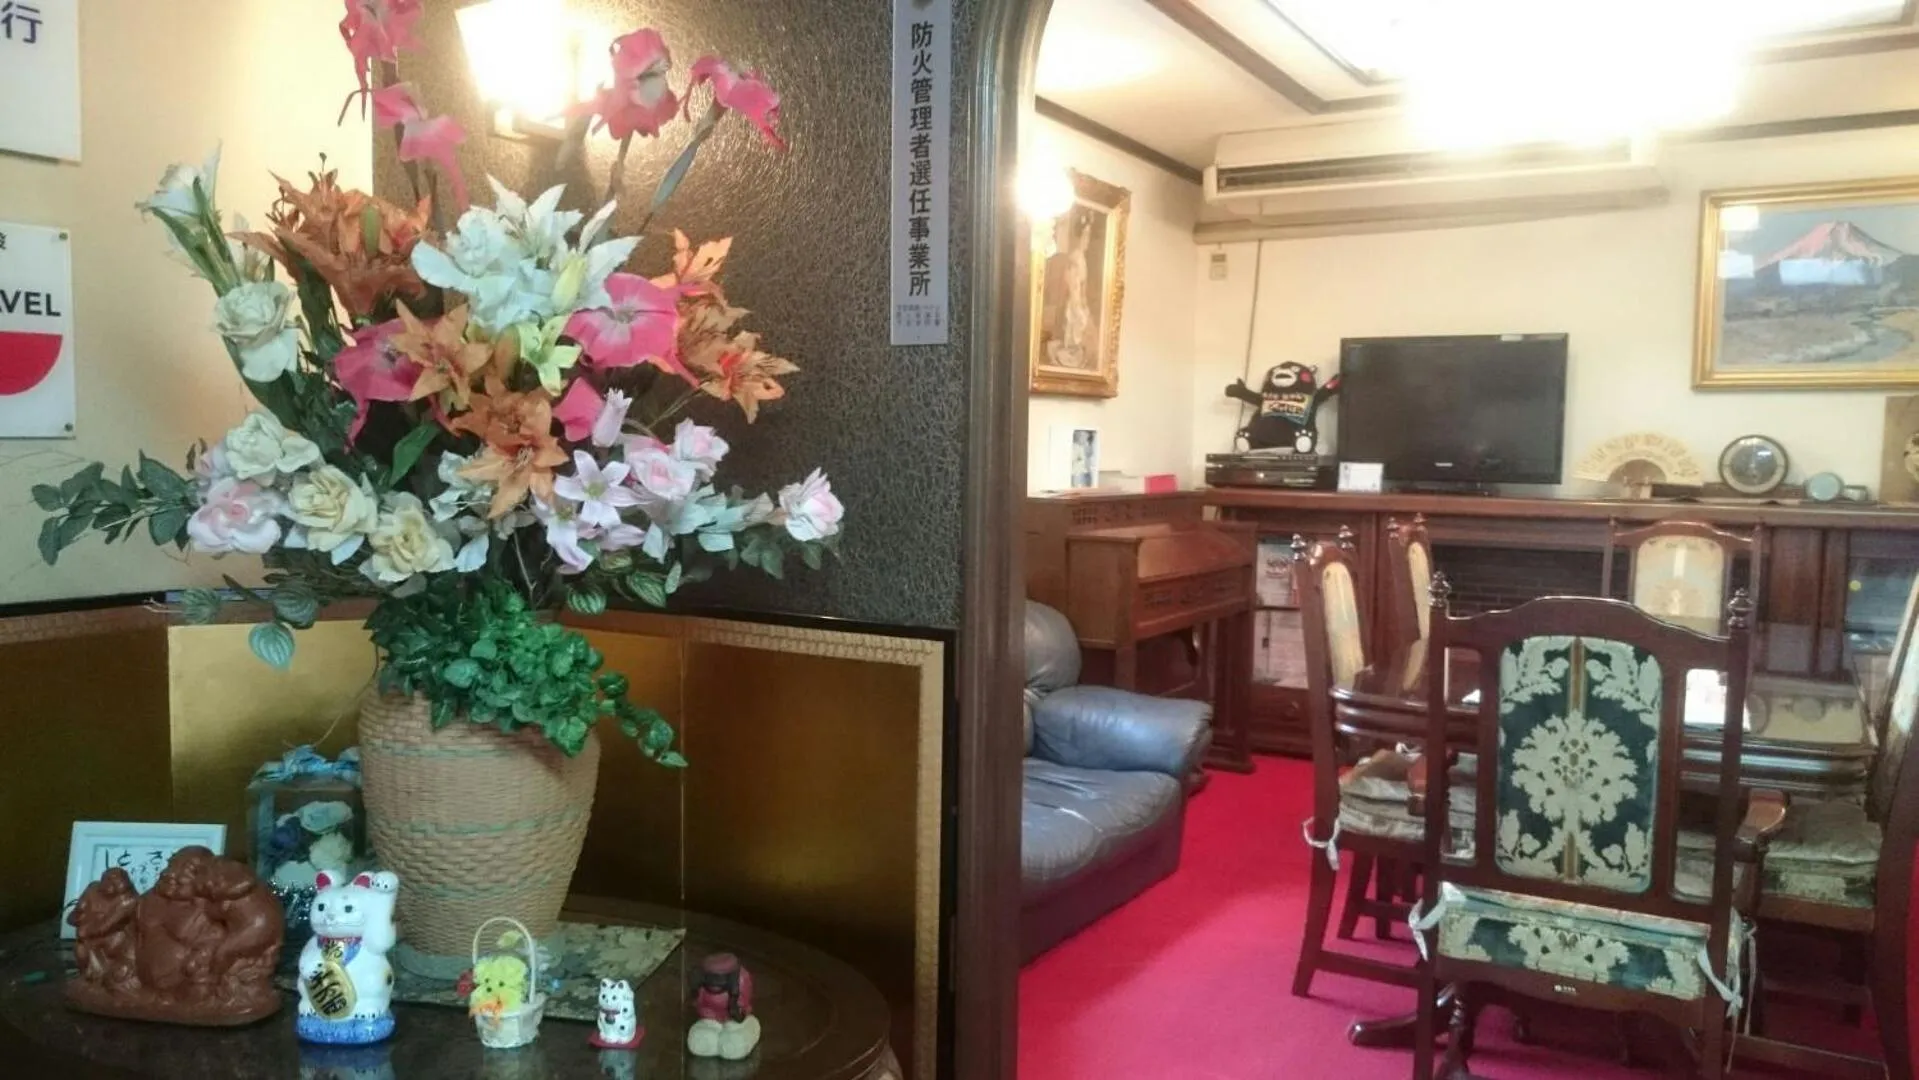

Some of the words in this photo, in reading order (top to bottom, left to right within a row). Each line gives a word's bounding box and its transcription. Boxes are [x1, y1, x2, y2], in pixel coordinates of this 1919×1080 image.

[1, 1, 44, 44] 行
[908, 20, 934, 297] 防火管理者選任事業所
[0, 289, 62, 317] VEL
